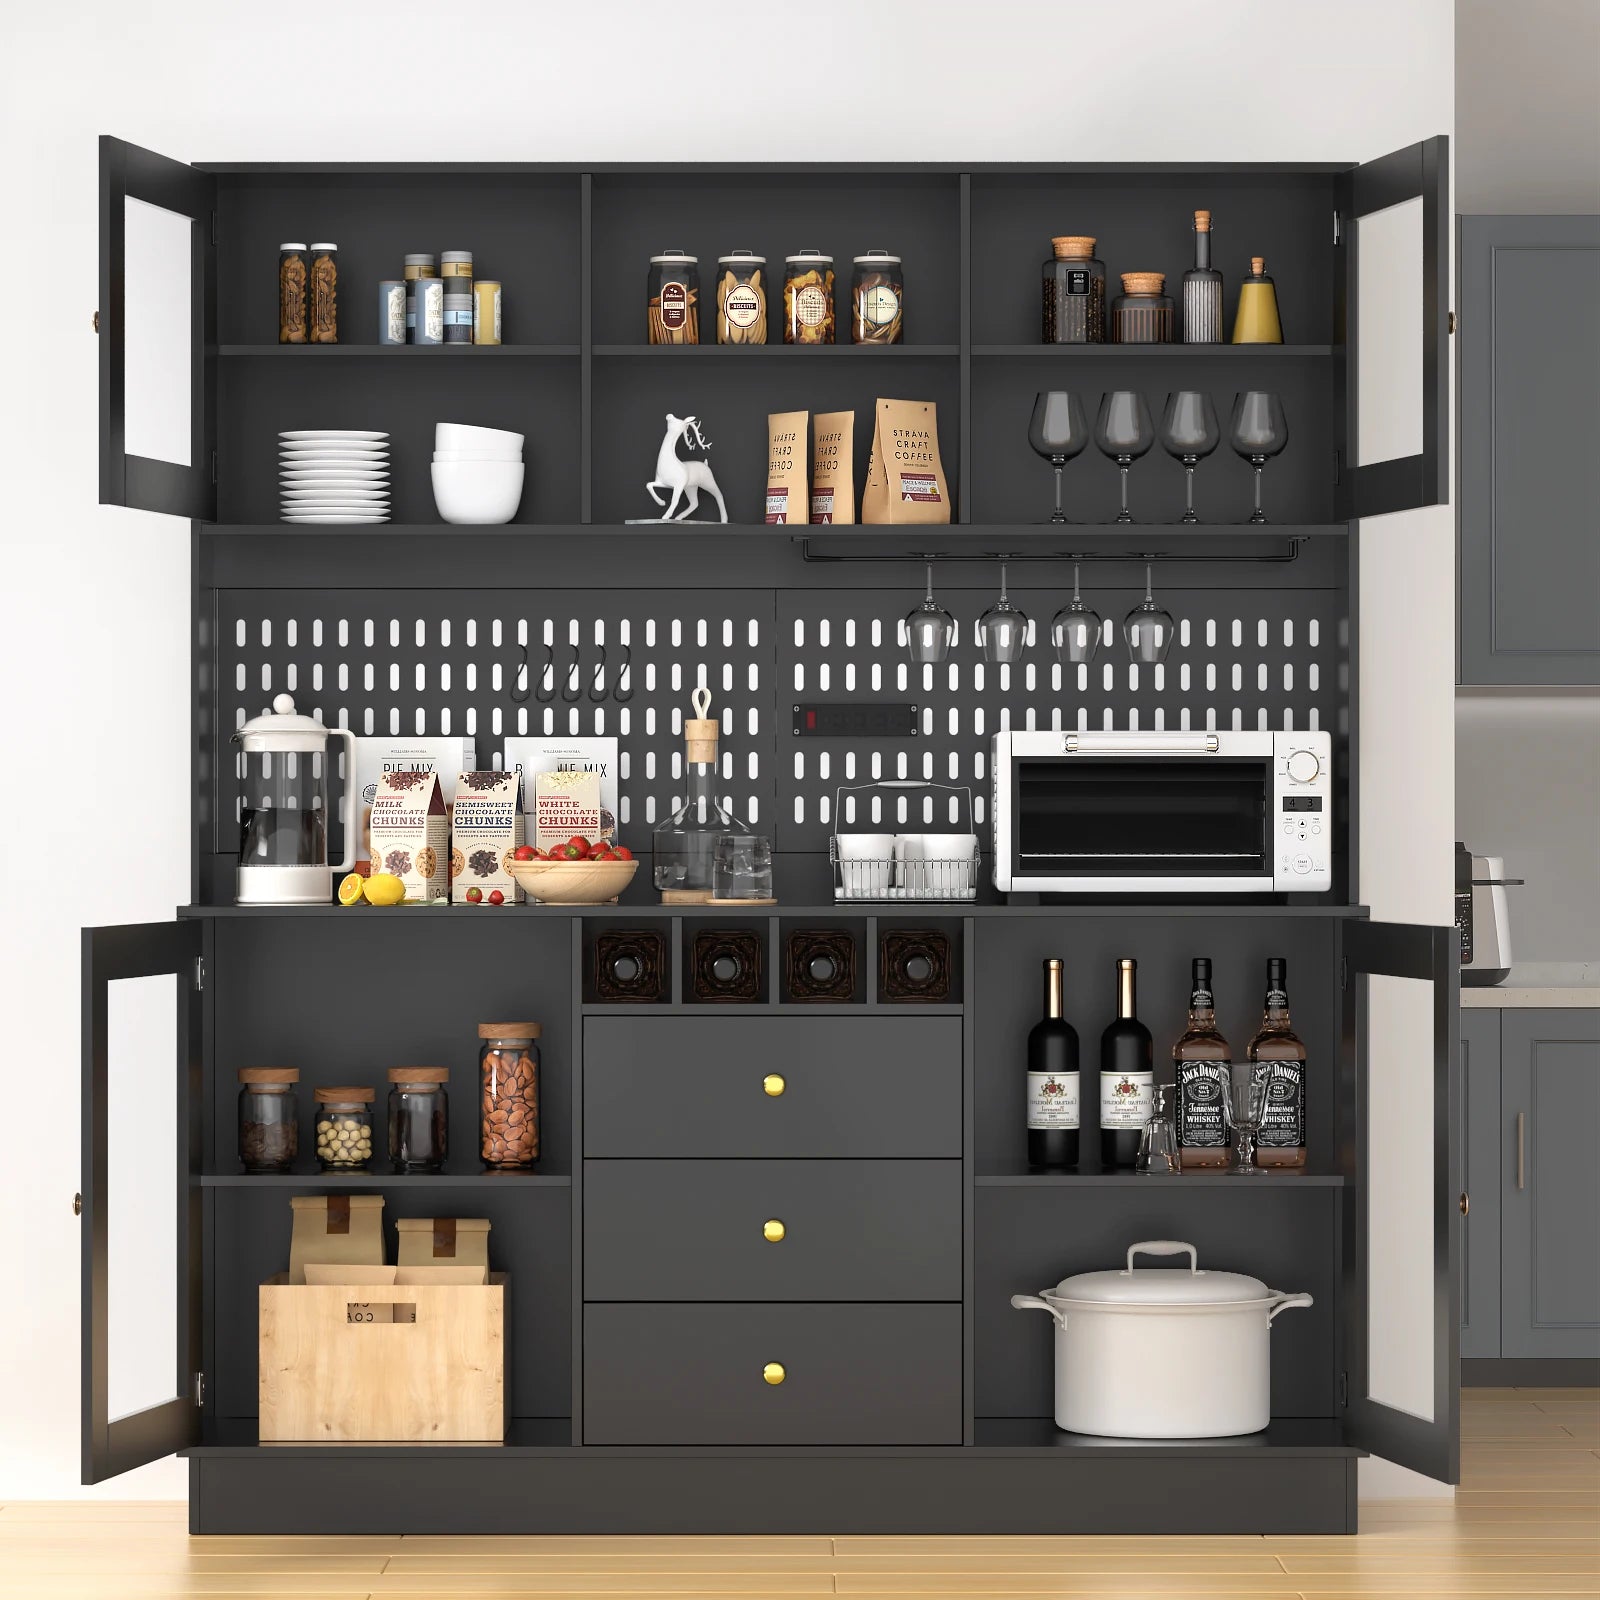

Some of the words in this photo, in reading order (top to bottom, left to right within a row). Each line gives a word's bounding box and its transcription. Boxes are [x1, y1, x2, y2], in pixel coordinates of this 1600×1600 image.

[893, 429, 930, 439] STRAVA
[896, 440, 928, 449] CRAFT
[894, 451, 933, 461] COFFEE
[584, 763, 607, 778] MIX
[372, 816, 425, 825] CHUNKS
[454, 816, 513, 825] CHUNKS
[538, 816, 598, 825] CHUNKS
[1182, 1066, 1200, 1084] JACK
[1188, 1102, 1220, 1113] Tennessee
[1266, 1105, 1295, 1113] ennessee
[1186, 1115, 1221, 1123] WHISKEY
